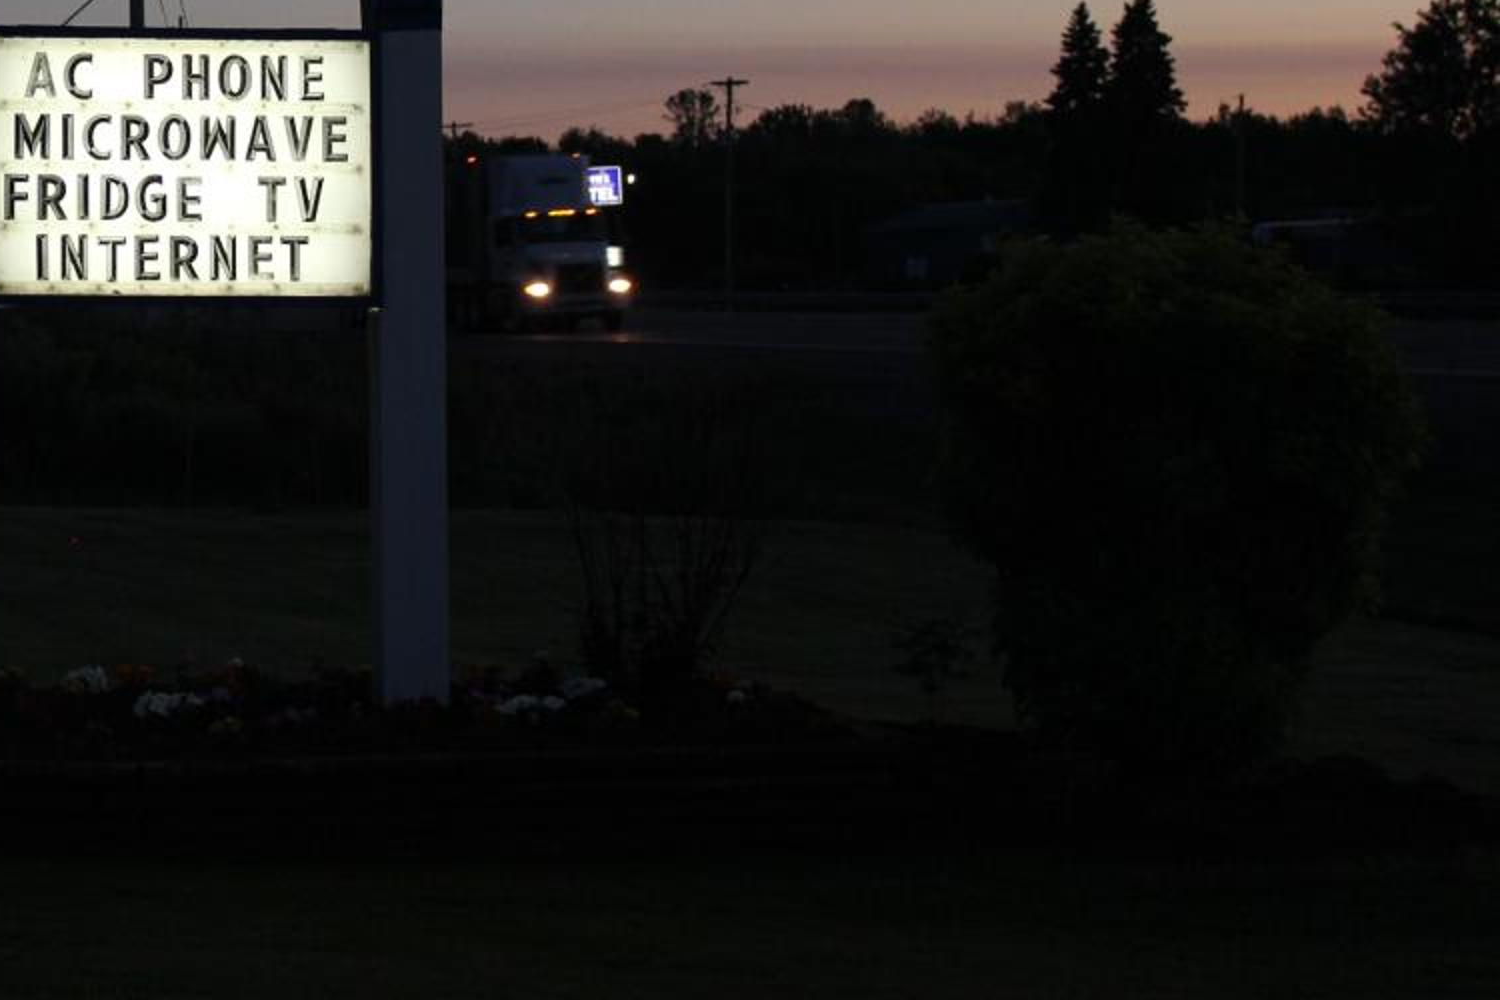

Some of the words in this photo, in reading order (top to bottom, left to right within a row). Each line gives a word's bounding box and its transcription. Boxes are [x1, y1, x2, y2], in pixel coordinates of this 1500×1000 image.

[24, 51, 93, 100] AC
[143, 53, 325, 101] PHONE
[13, 113, 349, 162] MICROWAVE
[3, 173, 203, 222] FRIDGE
[257, 176, 325, 222] TV
[35, 234, 309, 282] INTERNET
